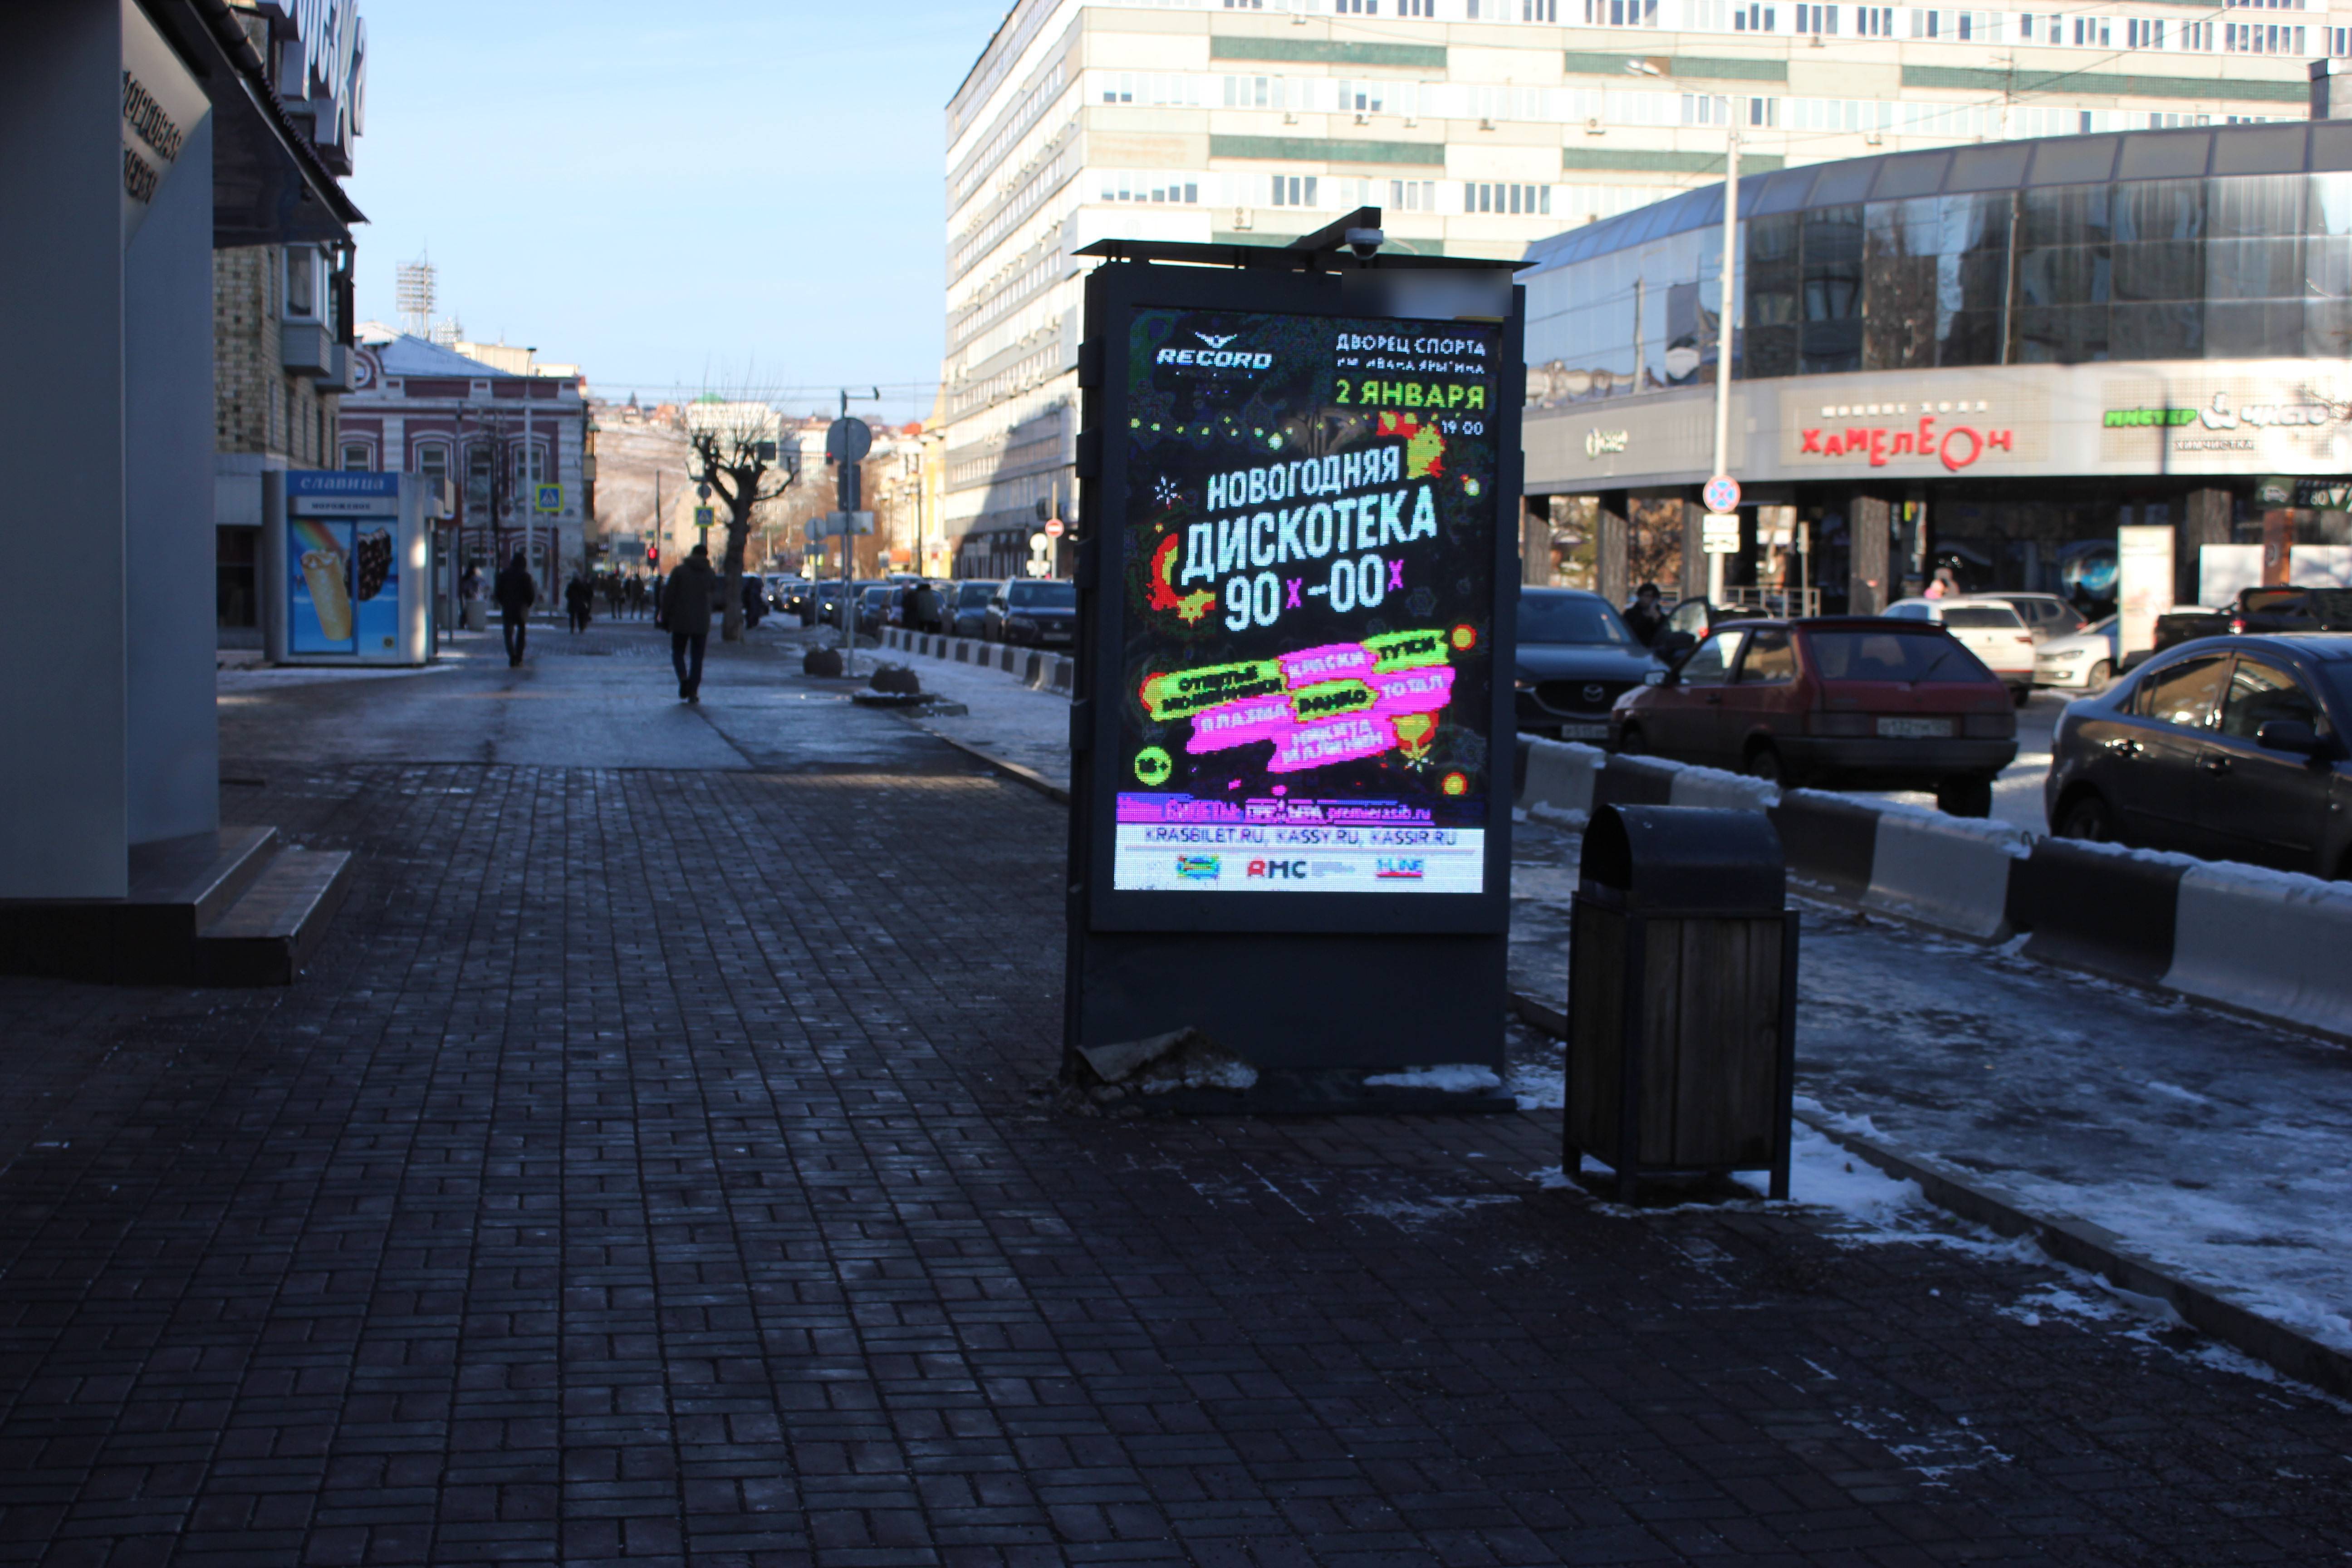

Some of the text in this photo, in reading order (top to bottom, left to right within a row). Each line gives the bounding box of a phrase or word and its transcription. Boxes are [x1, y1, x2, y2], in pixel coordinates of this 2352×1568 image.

[1336, 333, 1486, 356] ДВОРЕЦ СПОРТА
[1156, 348, 1273, 369] RECORD
[1336, 379, 1485, 410] 2 ЯНВАРЯ
[1441, 420, 1484, 435] 1900
[2103, 406, 2197, 427] МИСТЕР
[1801, 416, 2014, 471] ХАМЕЛЕОН
[2176, 439, 2254, 450] ХИМЧИСТКА
[1207, 445, 1400, 512] НОВОГОДНЯЯ
[1181, 485, 1437, 586] ДИСКОТЕКА
